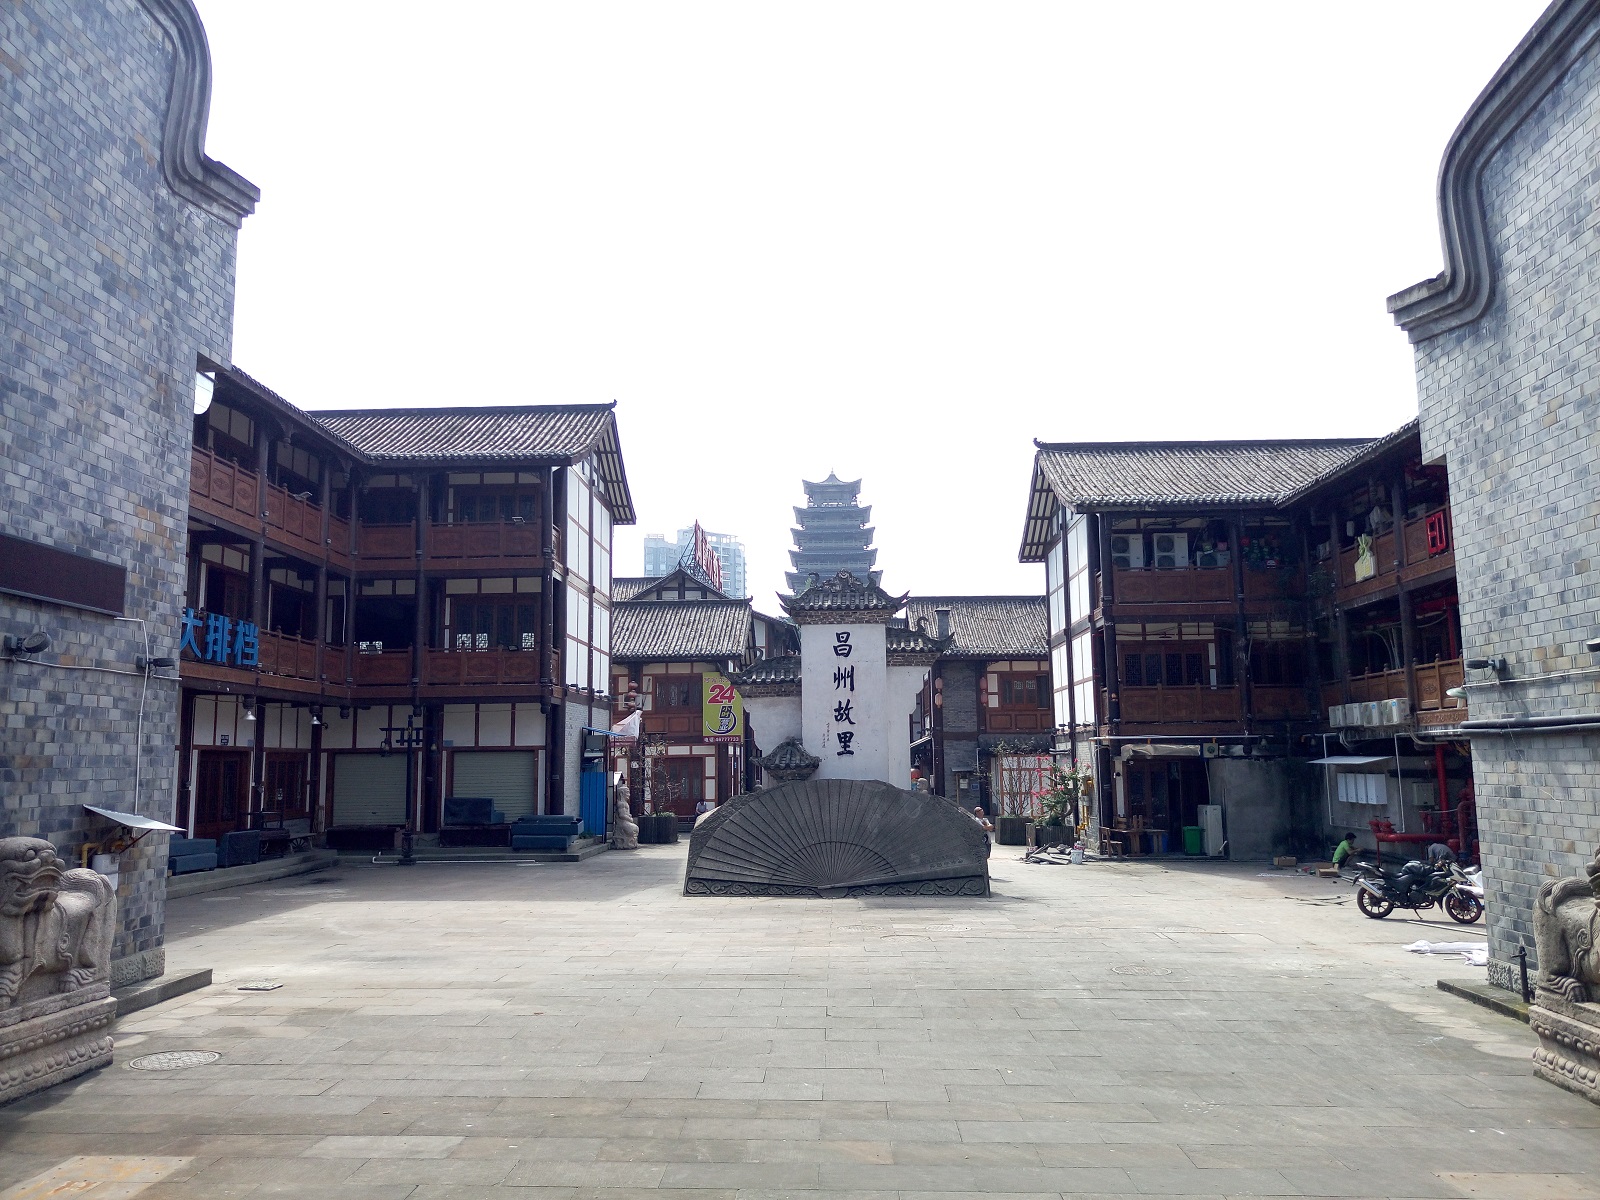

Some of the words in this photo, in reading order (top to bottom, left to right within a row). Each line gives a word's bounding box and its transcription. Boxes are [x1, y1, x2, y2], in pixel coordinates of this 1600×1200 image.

[180, 607, 259, 666] 大排档
[707, 684, 736, 704] 24
[833, 631, 856, 756] 昌州故里
